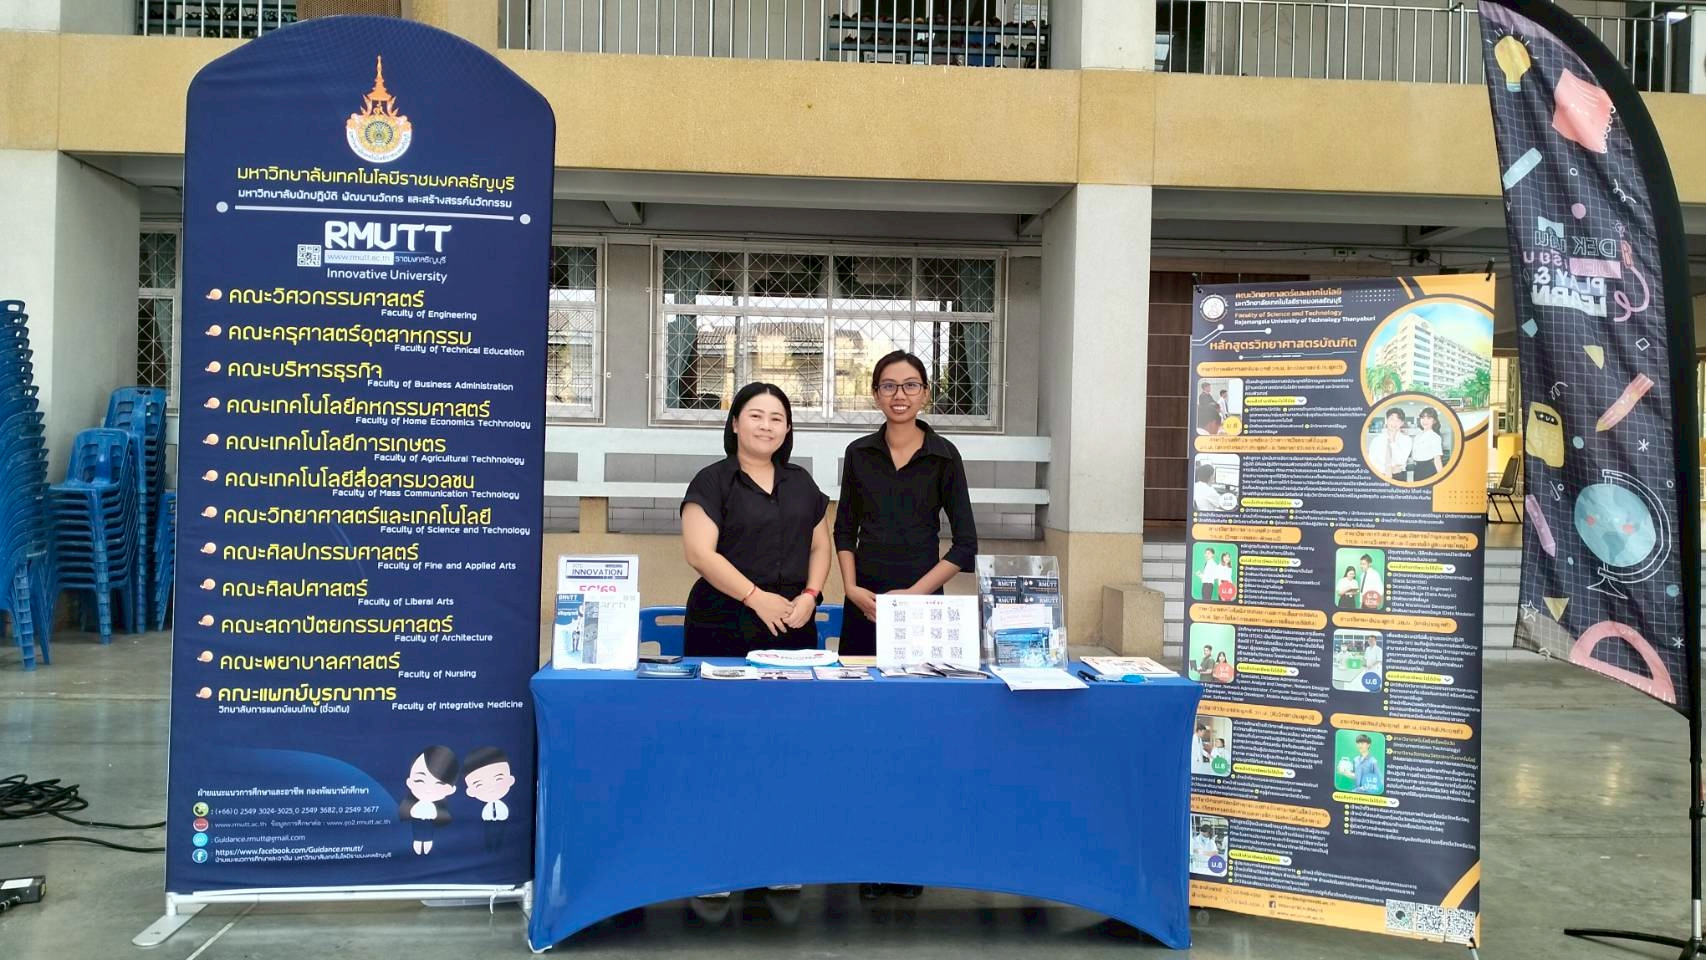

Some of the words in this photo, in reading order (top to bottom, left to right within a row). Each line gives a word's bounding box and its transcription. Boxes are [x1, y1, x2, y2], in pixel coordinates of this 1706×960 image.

[238, 166, 514, 194] มหาวิทยาลัยเทคโนโลยีราชมงคลธัญบุรี
[325, 221, 452, 253] RMUTT
[327, 268, 387, 279] Innovative
[390, 270, 447, 284] University
[230, 288, 424, 307] คณะวิศวกรรมศาสตร์
[381, 309, 413, 318] Faculty
[417, 310, 425, 318] of
[428, 311, 477, 320] Engineering
[229, 325, 471, 347] คณะครุศาสตร์อุตสาหกรรม
[395, 344, 426, 353] Faculty
[430, 345, 438, 353] of
[441, 346, 480, 354] Technical
[229, 361, 383, 383] คณะบริหารธุรกิจ
[368, 380, 399, 388] Faculty
[403, 380, 411, 388] of
[455, 382, 513, 390] Administration
[227, 393, 490, 418] คณะเทคโนโลยีคหกรรมศาสตร์
[356, 417, 387, 425] Faculty
[391, 417, 400, 425] of
[431, 418, 474, 426] Economics
[227, 430, 446, 452] คณะเทคโนโลยีการเกษตร
[375, 454, 406, 462] Faculty
[409, 454, 418, 462] of
[421, 455, 468, 463] Agricultural
[226, 467, 474, 488] คณะเทคโนโลยีสื่อสารมวลชน
[333, 489, 364, 497] Faculty
[368, 489, 377, 497] of
[471, 491, 519, 499] Technology
[225, 504, 491, 524] คณะวิทยาศาสตร์และเทคโนโลยี
[381, 526, 412, 534] Faculty
[416, 526, 424, 534] of
[482, 527, 530, 535] Technology
[224, 543, 419, 560] คณะศิลปกรรมศาสตร์
[378, 562, 409, 570] Faculty
[413, 562, 422, 570] of
[465, 562, 495, 570] Applied
[223, 579, 368, 596] คณะศิลปศาสตร์
[358, 598, 390, 606] Faculty
[393, 598, 402, 606] of
[222, 615, 453, 633] คณะสถาปัตยกรรมศาสตร์
[395, 635, 426, 643] Faculty
[430, 634, 438, 642] of
[221, 652, 400, 670] คณะพยาบาลศาสตร์
[399, 671, 430, 679] Faculty
[433, 670, 442, 679] of
[445, 670, 476, 678] Nursing
[219, 684, 397, 704] คณะแพทย์บูรณาการ
[392, 702, 424, 711] Faculty
[427, 702, 436, 711] of
[439, 702, 484, 710] Integrative
[214, 834, 306, 843] Guidance.rmutt@gmail.com
[216, 846, 364, 856] https://www.facebook.com/Guidance.rmutt/
